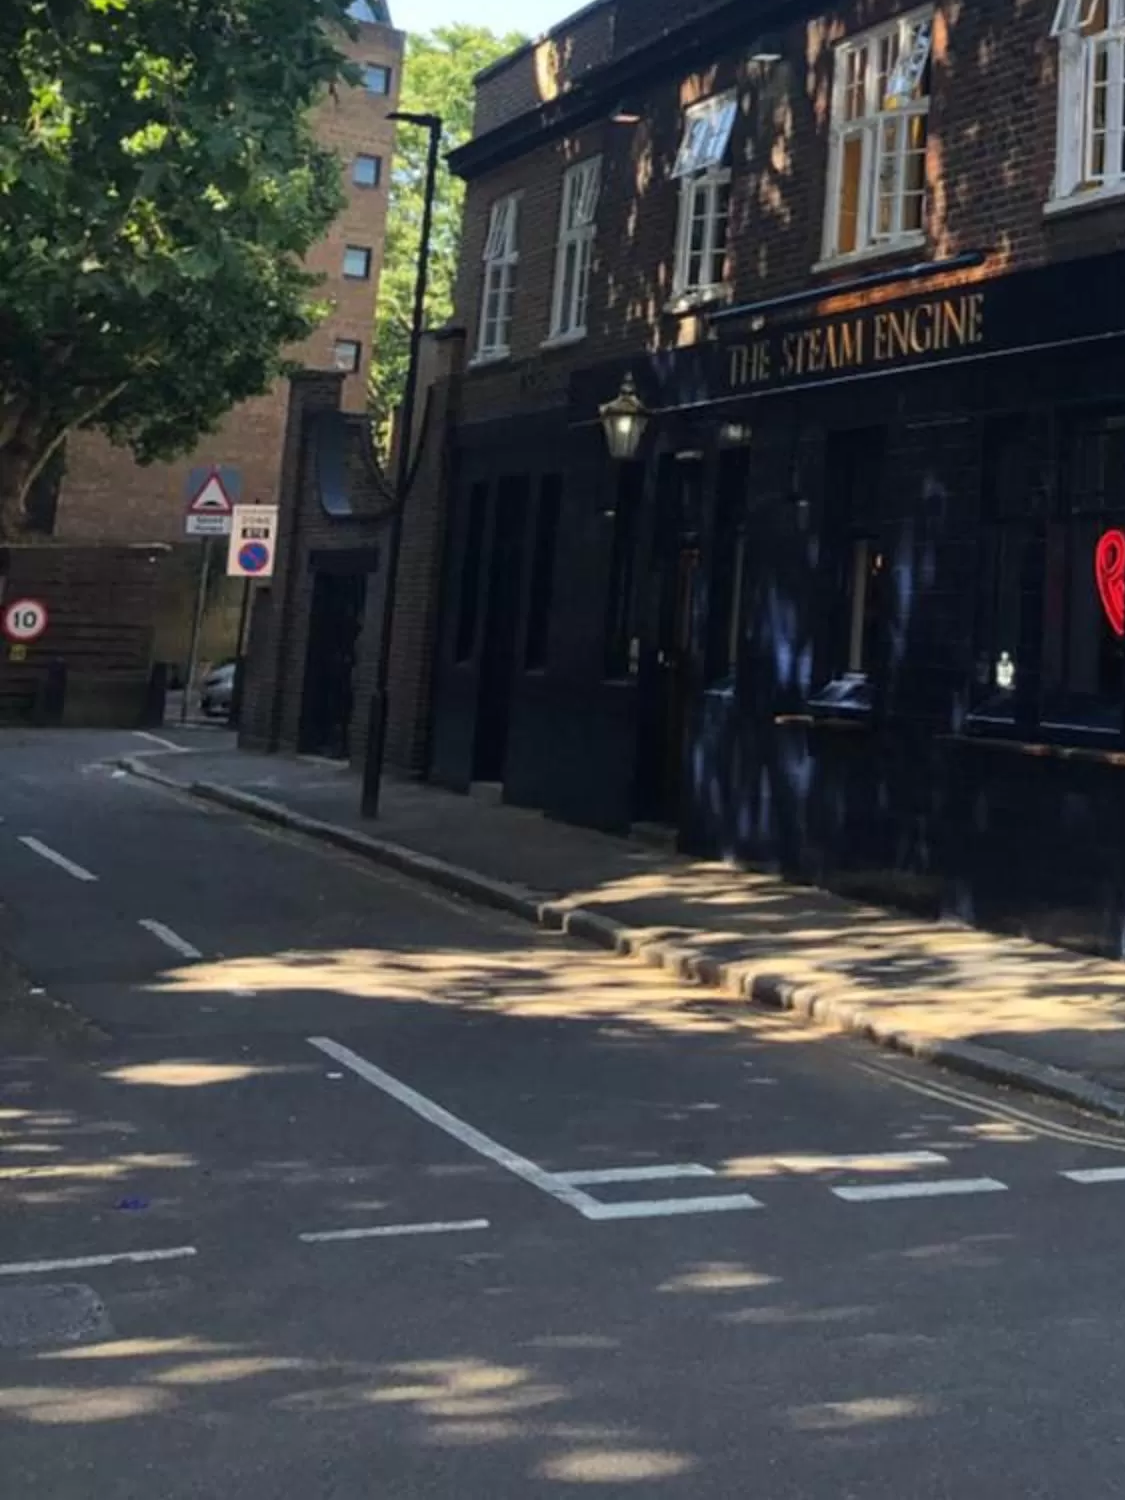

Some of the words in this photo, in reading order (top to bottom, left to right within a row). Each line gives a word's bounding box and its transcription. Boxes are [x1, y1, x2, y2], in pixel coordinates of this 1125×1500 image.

[727, 341, 771, 387] THE
[780, 317, 863, 377] STEAM
[873, 293, 986, 362] ENGINE
[14, 610, 37, 629] 10
